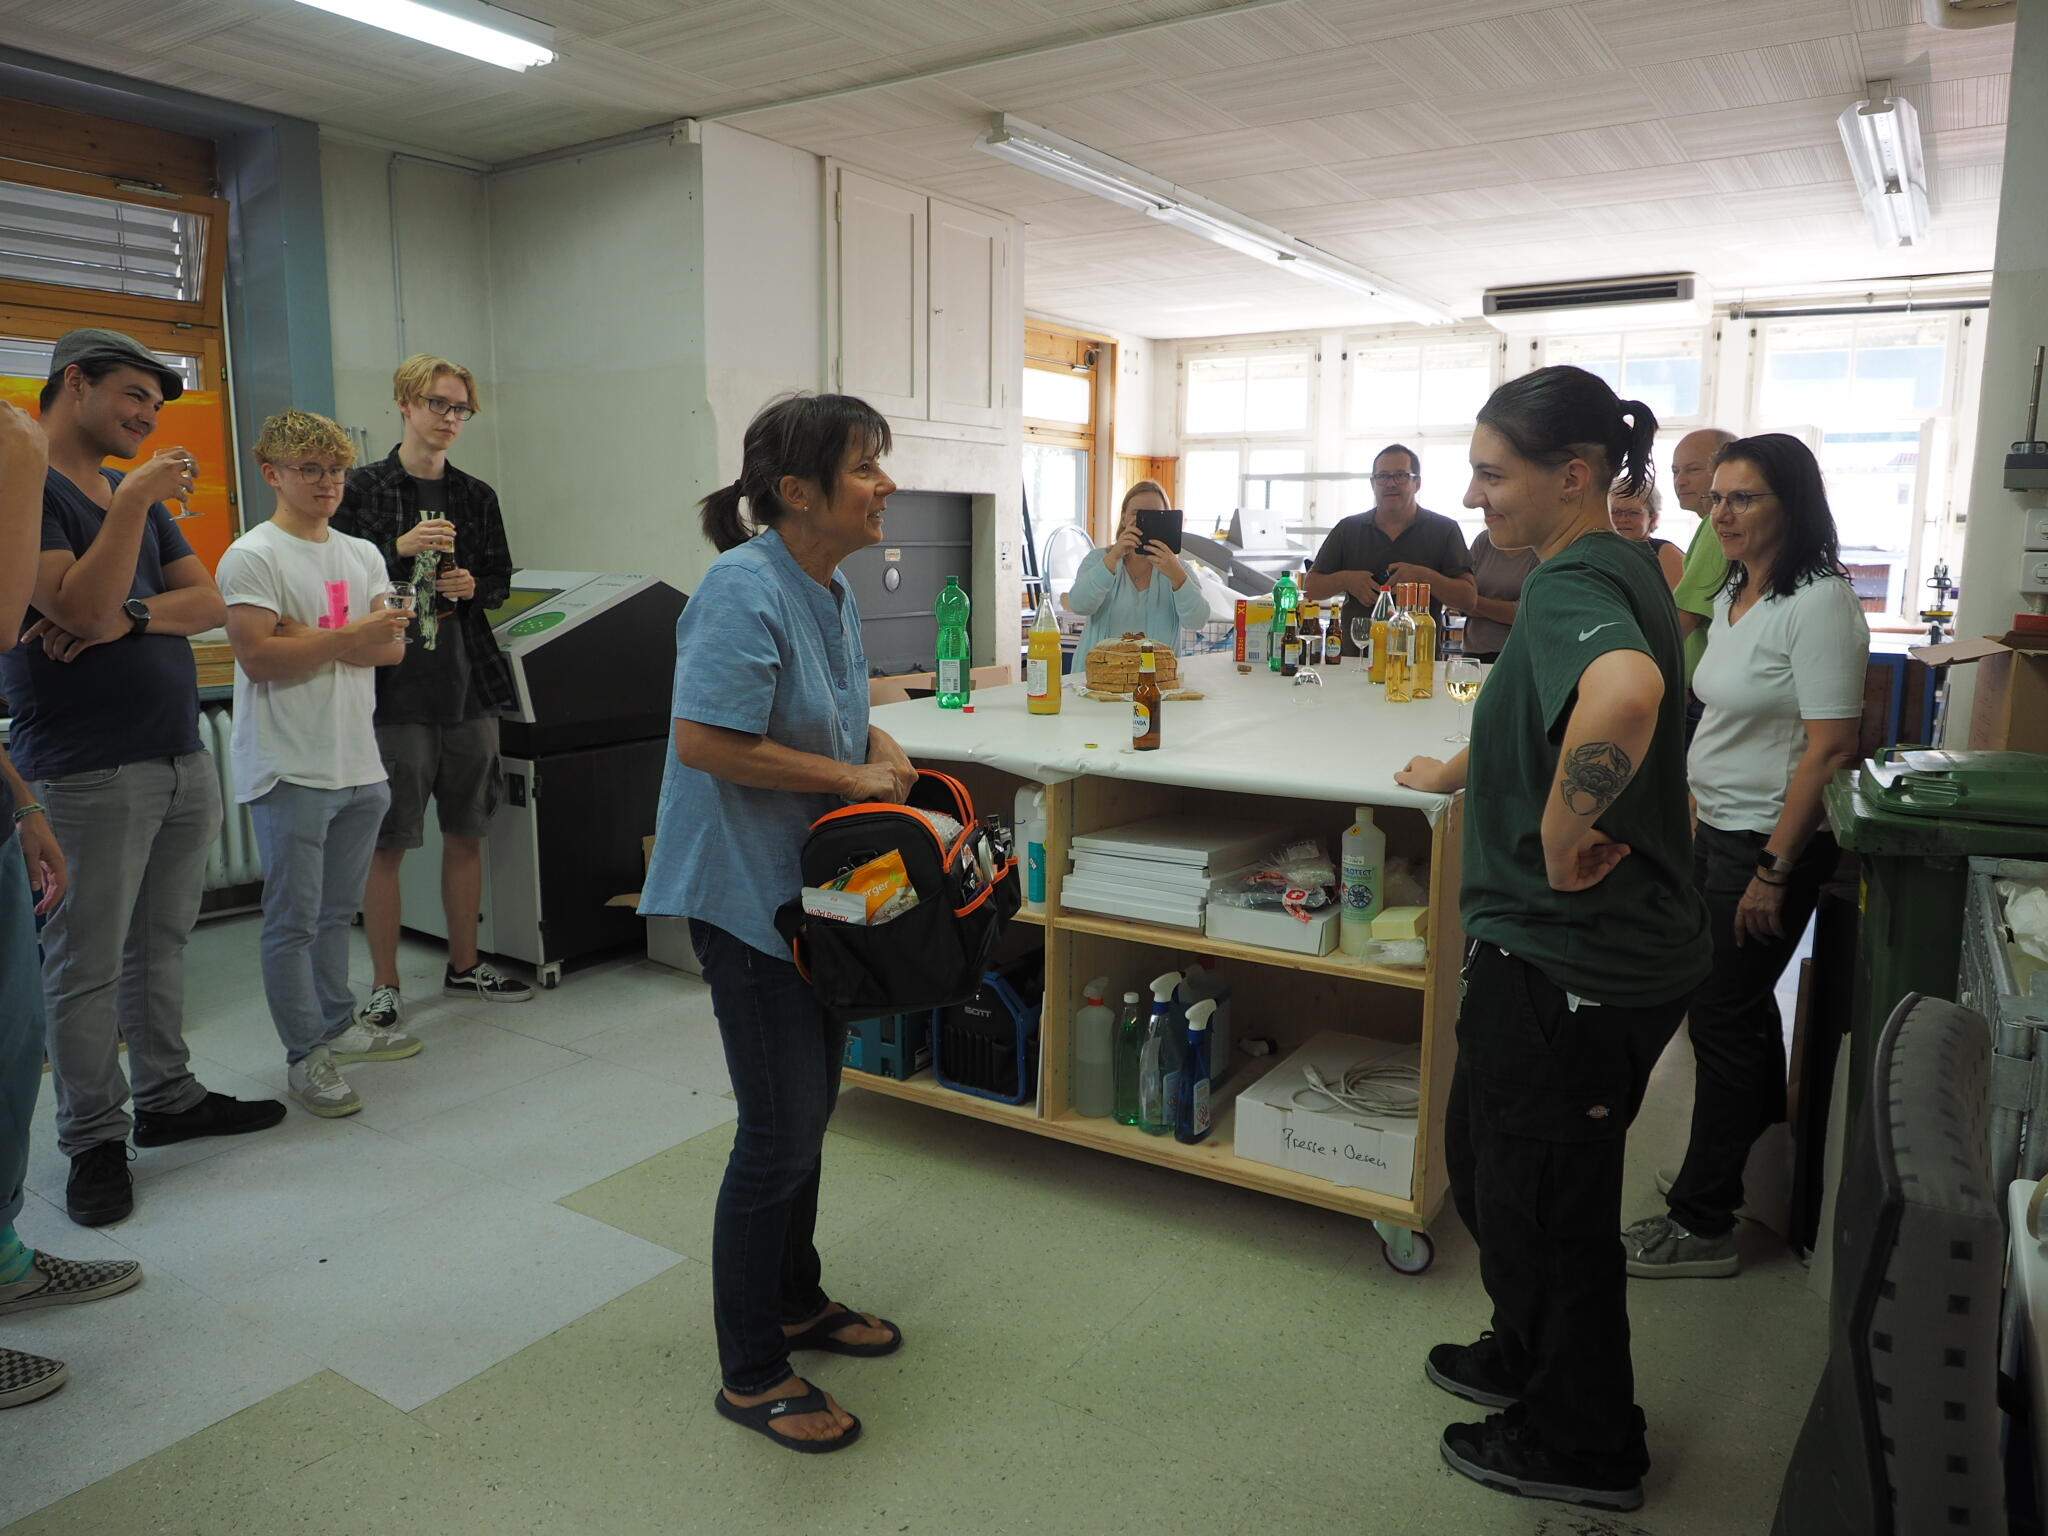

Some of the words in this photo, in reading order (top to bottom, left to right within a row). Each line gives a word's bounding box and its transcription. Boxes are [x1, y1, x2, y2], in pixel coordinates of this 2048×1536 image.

[1237, 601, 1246, 615] XL
[1282, 1127, 1327, 1155] Presse
[1331, 1147, 1337, 1156] +
